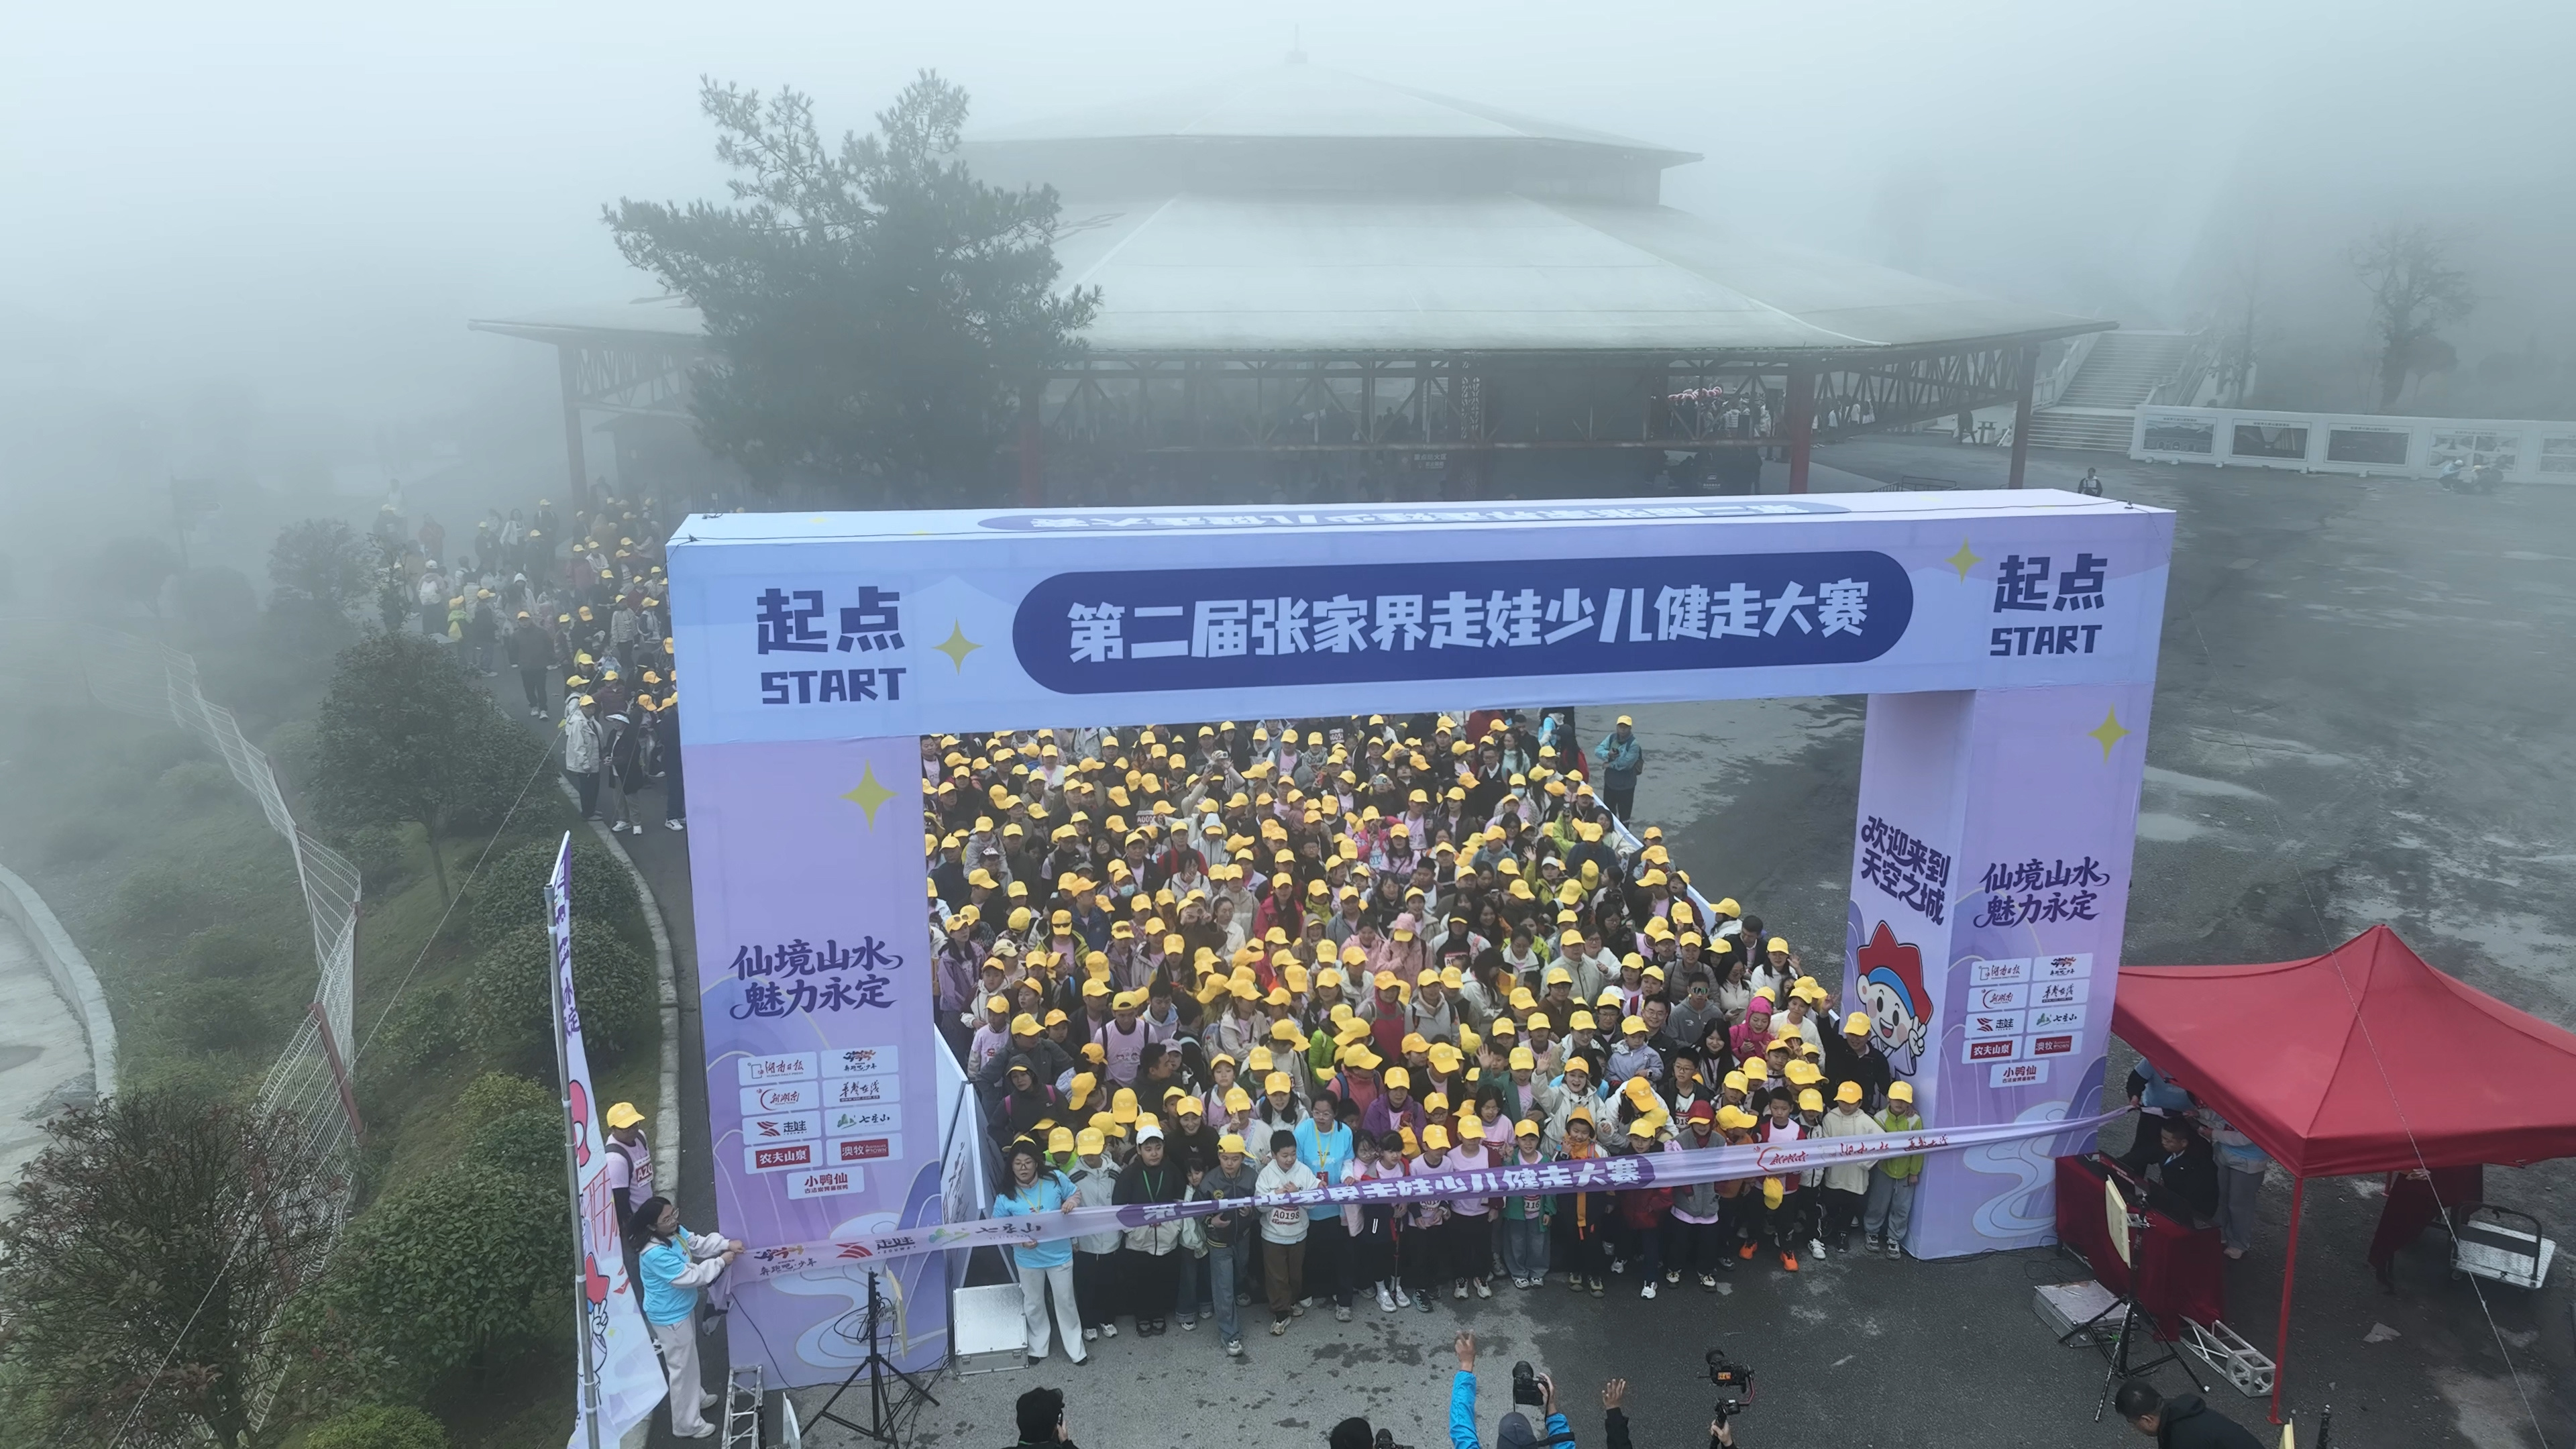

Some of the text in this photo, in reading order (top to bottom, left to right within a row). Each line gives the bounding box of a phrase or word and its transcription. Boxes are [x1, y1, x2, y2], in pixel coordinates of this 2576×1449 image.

[1993, 553, 2108, 613] 起点
[756, 586, 905, 654] 起点
[1068, 578, 1870, 662] 第二届张家界走娃少儿健走大赛
[1990, 625, 2102, 656] START
[761, 667, 906, 704] START
[1861, 815, 1951, 885] 欢迎来到
[1861, 847, 1945, 926] 天空之城
[1980, 856, 2110, 894] 仙境山水
[1973, 890, 2100, 928] 魅力永定
[729, 936, 904, 981] 仙境山水
[730, 974, 898, 1020] 魅力永定
[1974, 1044, 2011, 1056] 农夫山泉
[765, 1059, 804, 1073] 湖南日报
[2003, 1065, 2037, 1077] 小鸭仙
[784, 1120, 807, 1133] 走娃
[859, 1114, 890, 1123] 七星山
[759, 1150, 807, 1165] 农夫山泉
[842, 1145, 864, 1156] 澳牧
[804, 1173, 848, 1187] 小鸭仙
[1273, 1210, 1300, 1220] A0198
[975, 1223, 1042, 1234] 七星山
[875, 1236, 915, 1250] 走娃
